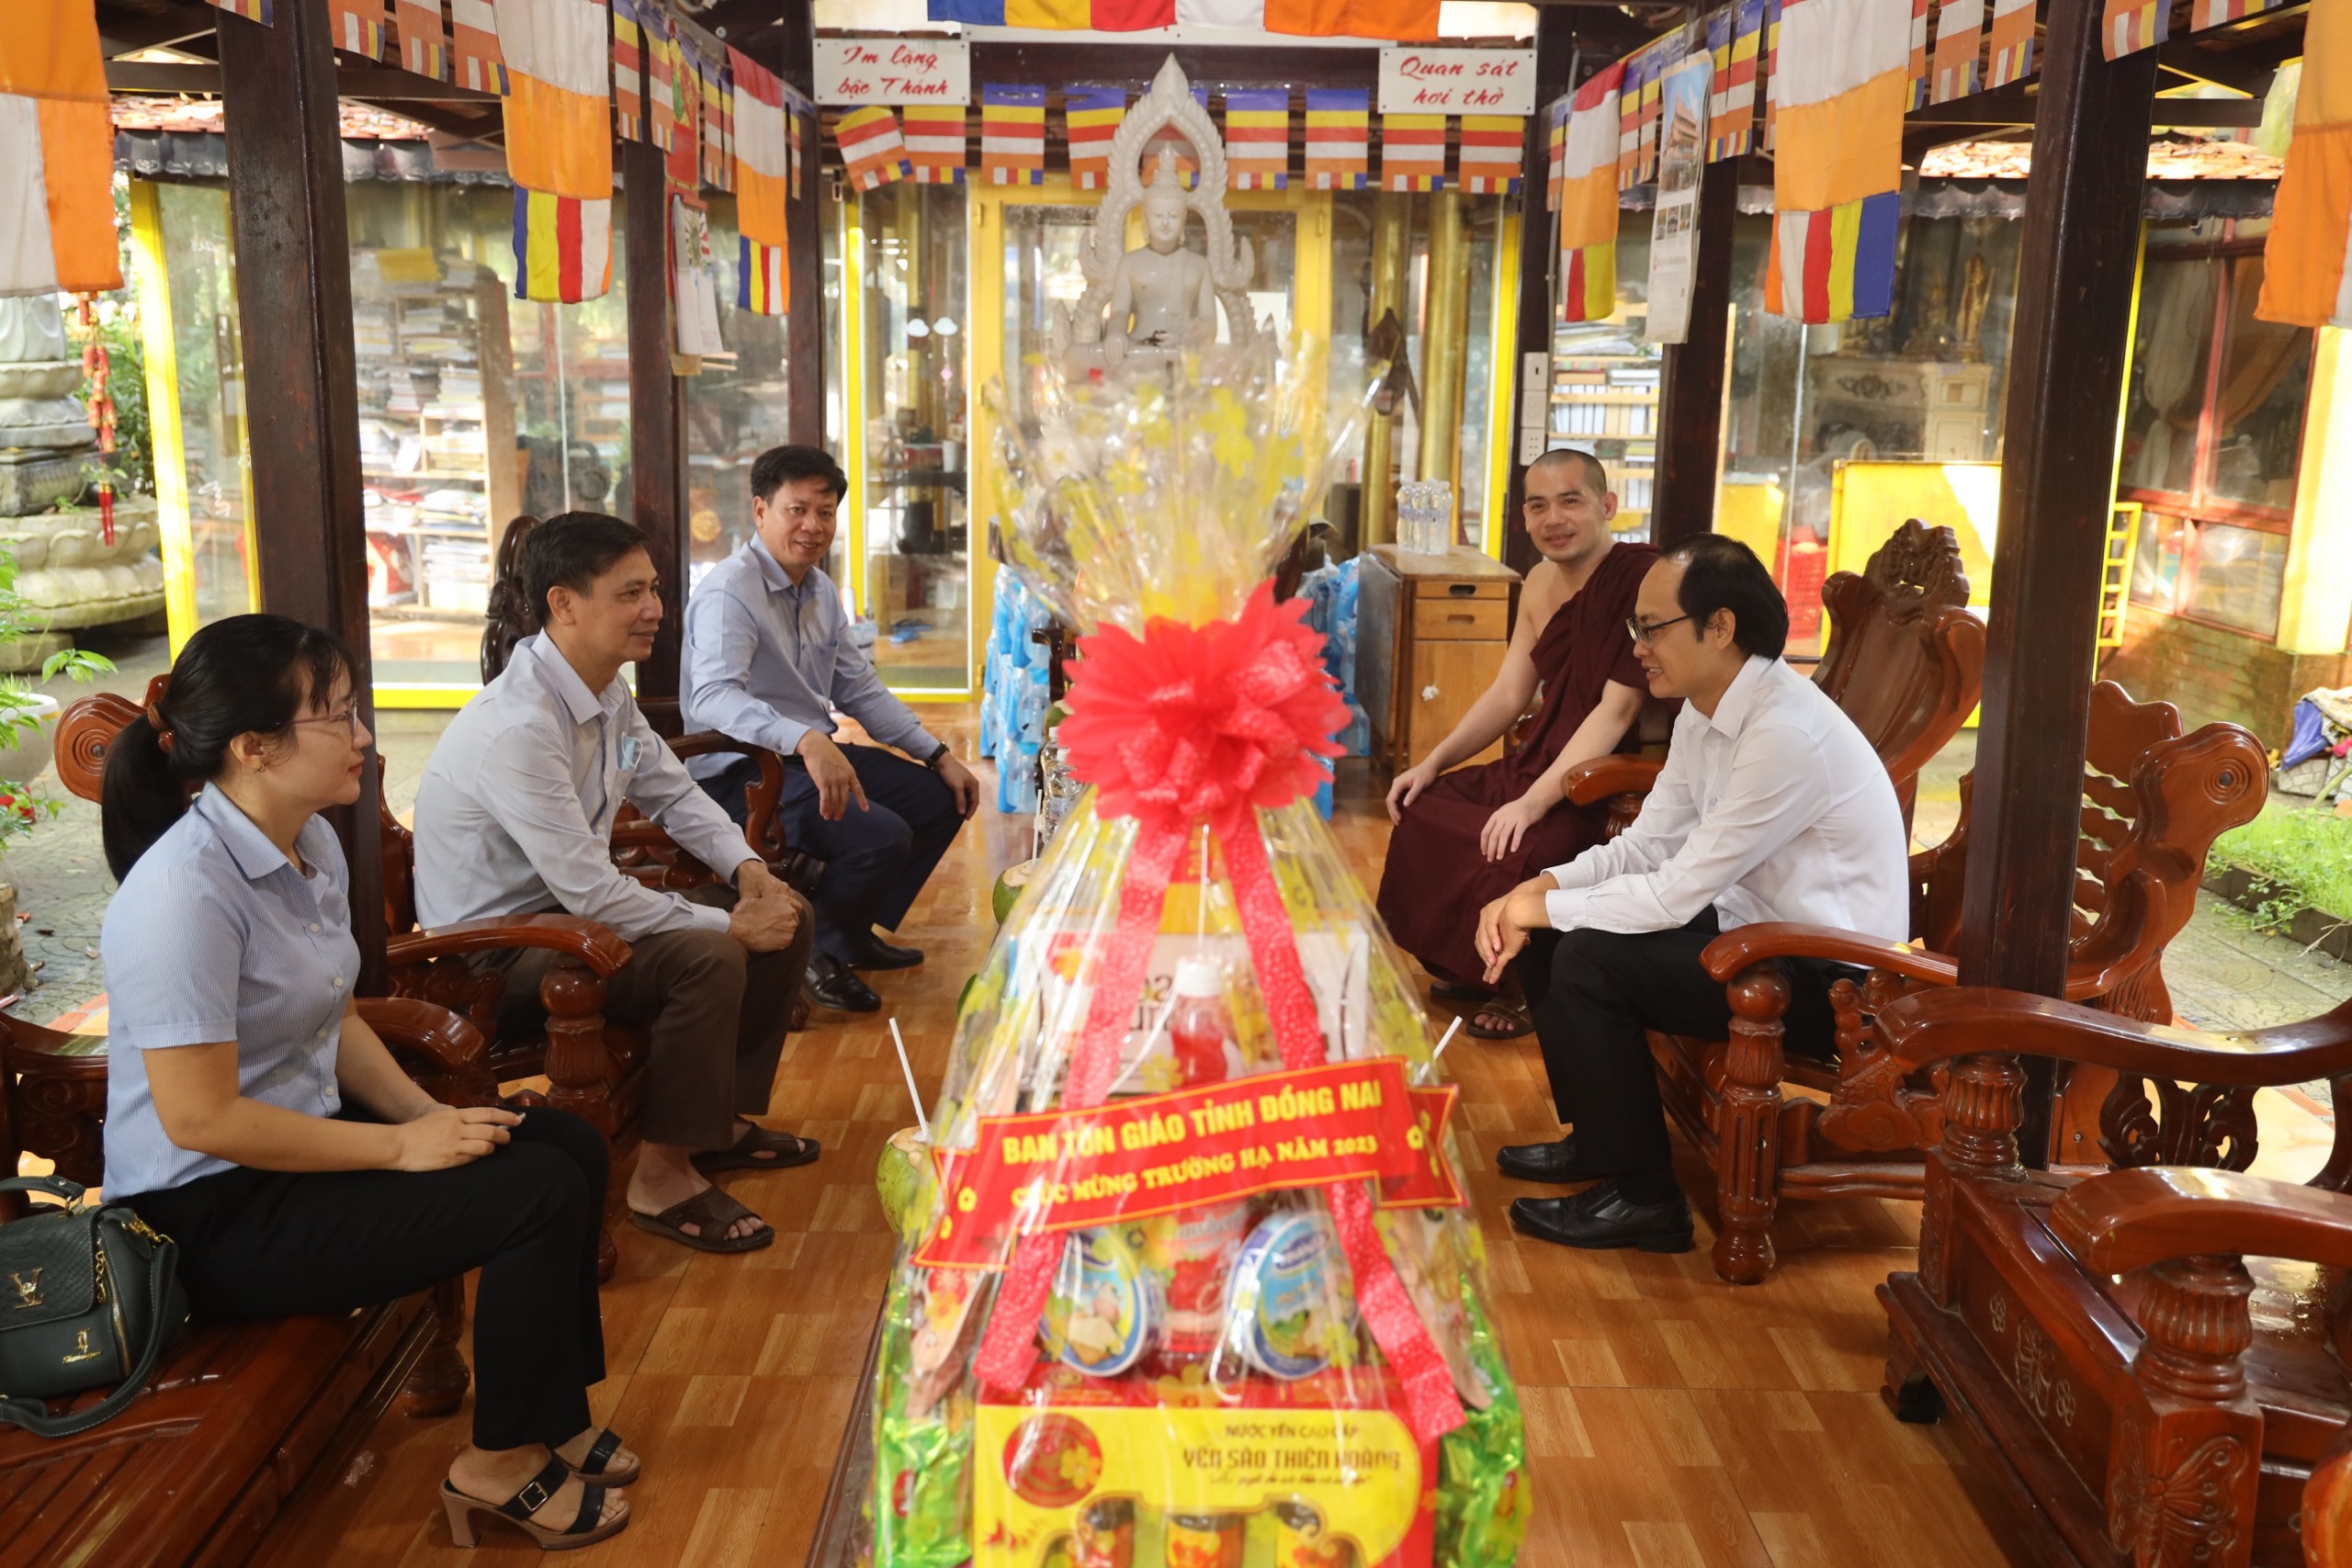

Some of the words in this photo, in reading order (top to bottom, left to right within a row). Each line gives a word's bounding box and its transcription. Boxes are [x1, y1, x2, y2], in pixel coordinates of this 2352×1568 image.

[842, 45, 878, 64] Im
[889, 44, 938, 73] lặng
[1399, 55, 1464, 81] Quan
[1476, 59, 1519, 76] sát
[835, 77, 871, 98] bậc
[880, 76, 948, 96] Thánh
[1412, 87, 1453, 105] hơi
[1463, 86, 1504, 105] thở
[1001, 1132, 1057, 1165] BAN
[1061, 1122, 1116, 1159] TÔN
[1120, 1111, 1187, 1151] GIÁO
[1190, 1098, 1255, 1137] TỈNH
[1339, 1078, 1383, 1111] NAI
[1071, 1172, 1138, 1202] MỪNG
[1140, 1152, 1236, 1190] TRƯỜNG
[1238, 1145, 1272, 1170] HẠ
[1275, 1135, 1329, 1162] NĂM
[1332, 1134, 1379, 1156] 2023
